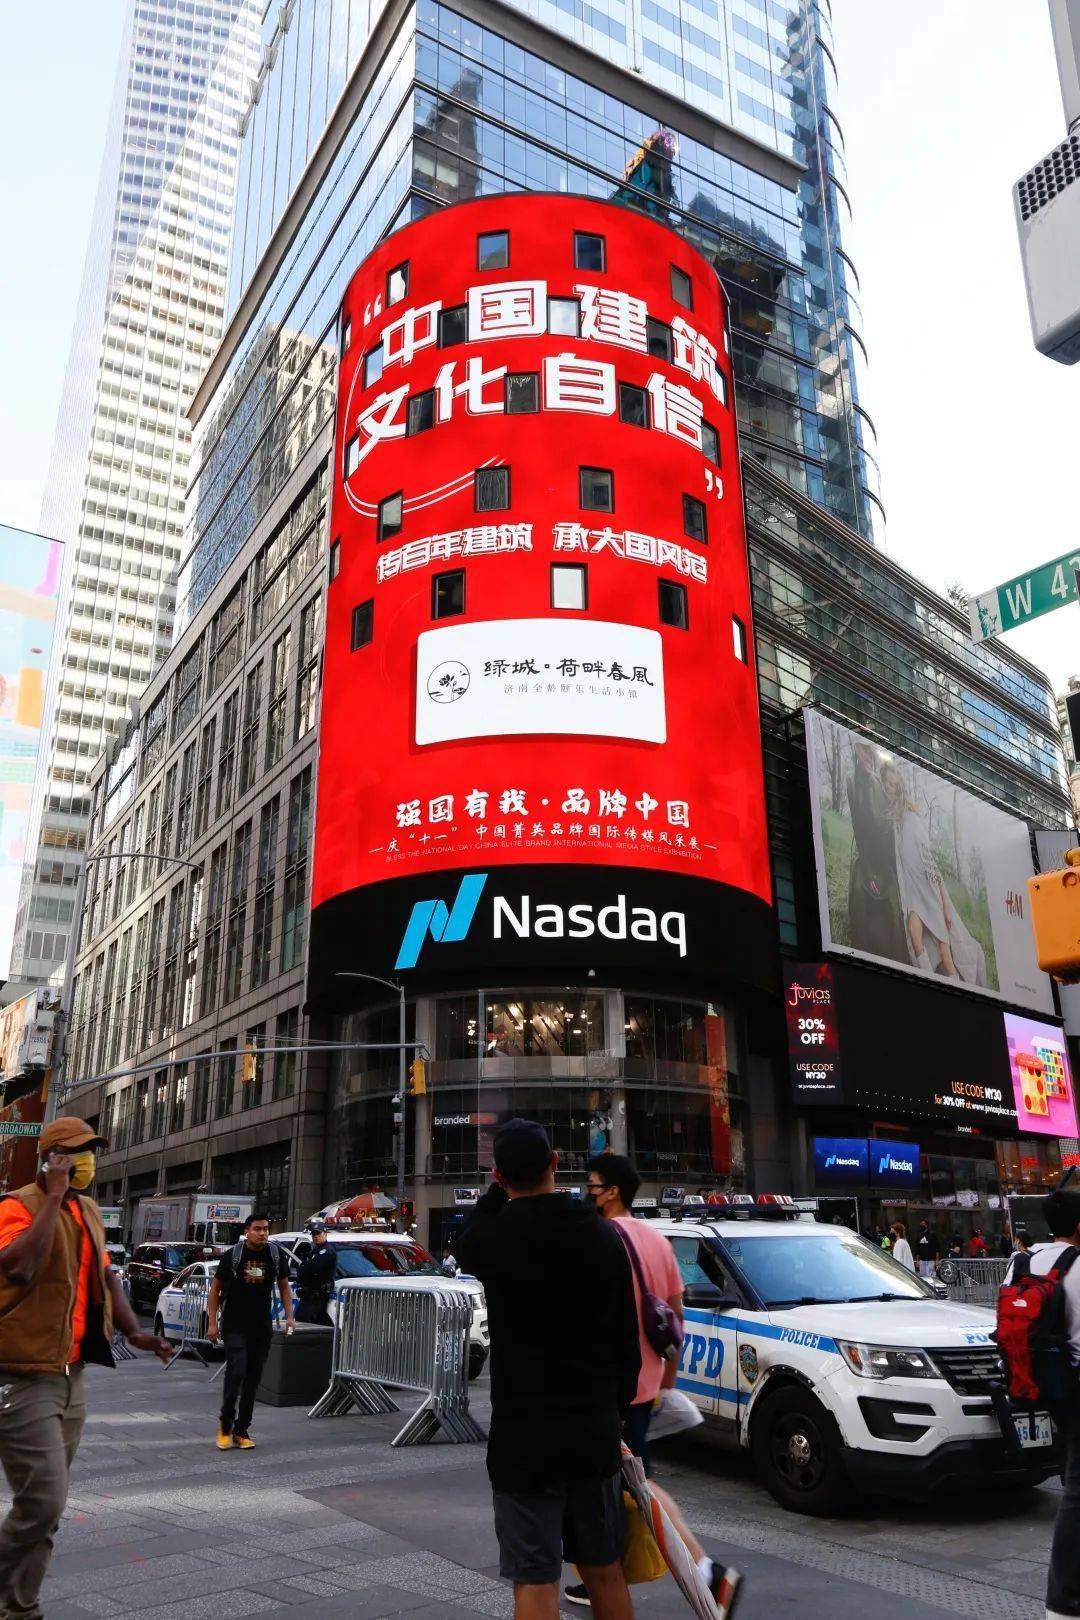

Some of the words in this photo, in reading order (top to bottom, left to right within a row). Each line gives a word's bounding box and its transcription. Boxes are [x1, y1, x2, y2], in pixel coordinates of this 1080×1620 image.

[376, 523, 533, 584] 传百年建筑
[552, 522, 708, 585] 承大国风范
[1005, 578, 1032, 620] W
[408, 849, 420, 858] THE
[525, 839, 552, 847] BRAND
[553, 839, 612, 848] INTERNATIONAL
[493, 895, 687, 957] Nasdaq
[798, 1019, 826, 1030] 30%
[801, 1033, 825, 1045] OFF
[796, 1063, 811, 1071] USE
[811, 1063, 834, 1071] CODE
[951, 1081, 965, 1094] USE
[965, 1084, 985, 1098] CODE
[984, 1087, 1002, 1101] NY30
[935, 1094, 943, 1104] for
[955, 1098, 966, 1108] OFF
[434, 1115, 470, 1125] branded
[0, 1122, 38, 1135] BROADWAY
[836, 1158, 859, 1167] Nasdaq
[890, 1159, 912, 1174] Nasdaq
[781, 1328, 820, 1349] POLICE
[677, 1333, 725, 1378] YPD
